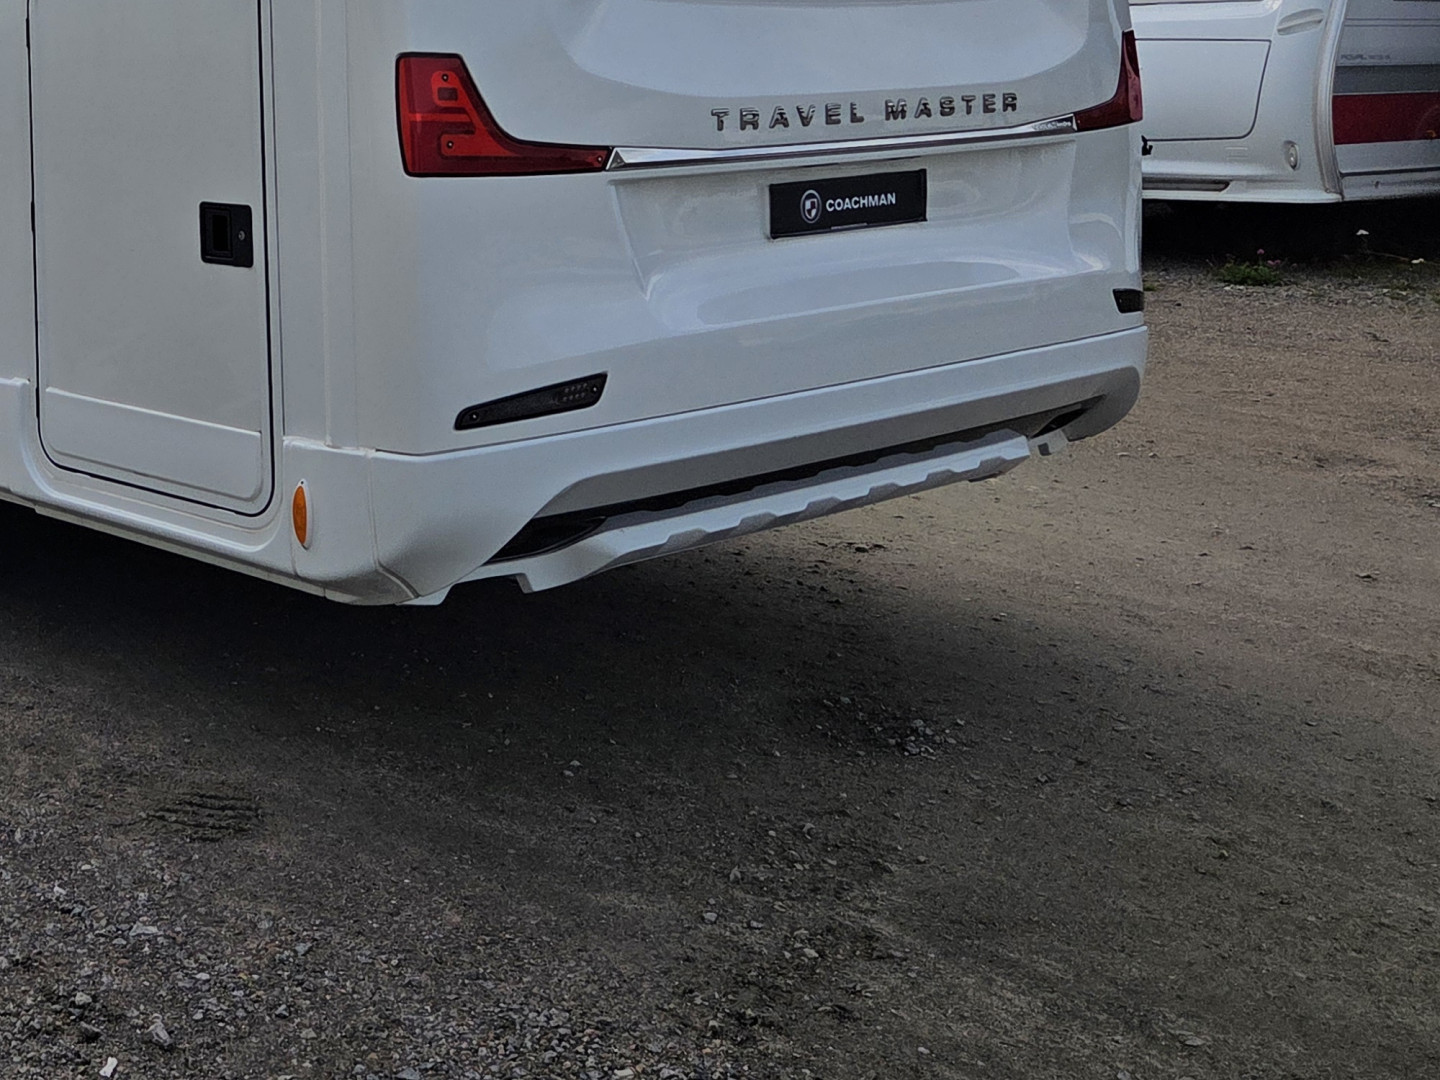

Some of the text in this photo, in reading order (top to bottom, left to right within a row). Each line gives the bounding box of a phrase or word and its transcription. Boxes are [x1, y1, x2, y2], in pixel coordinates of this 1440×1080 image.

[711, 92, 1019, 132] TRAVEL MASTER
[825, 192, 896, 212] COACHMAN
